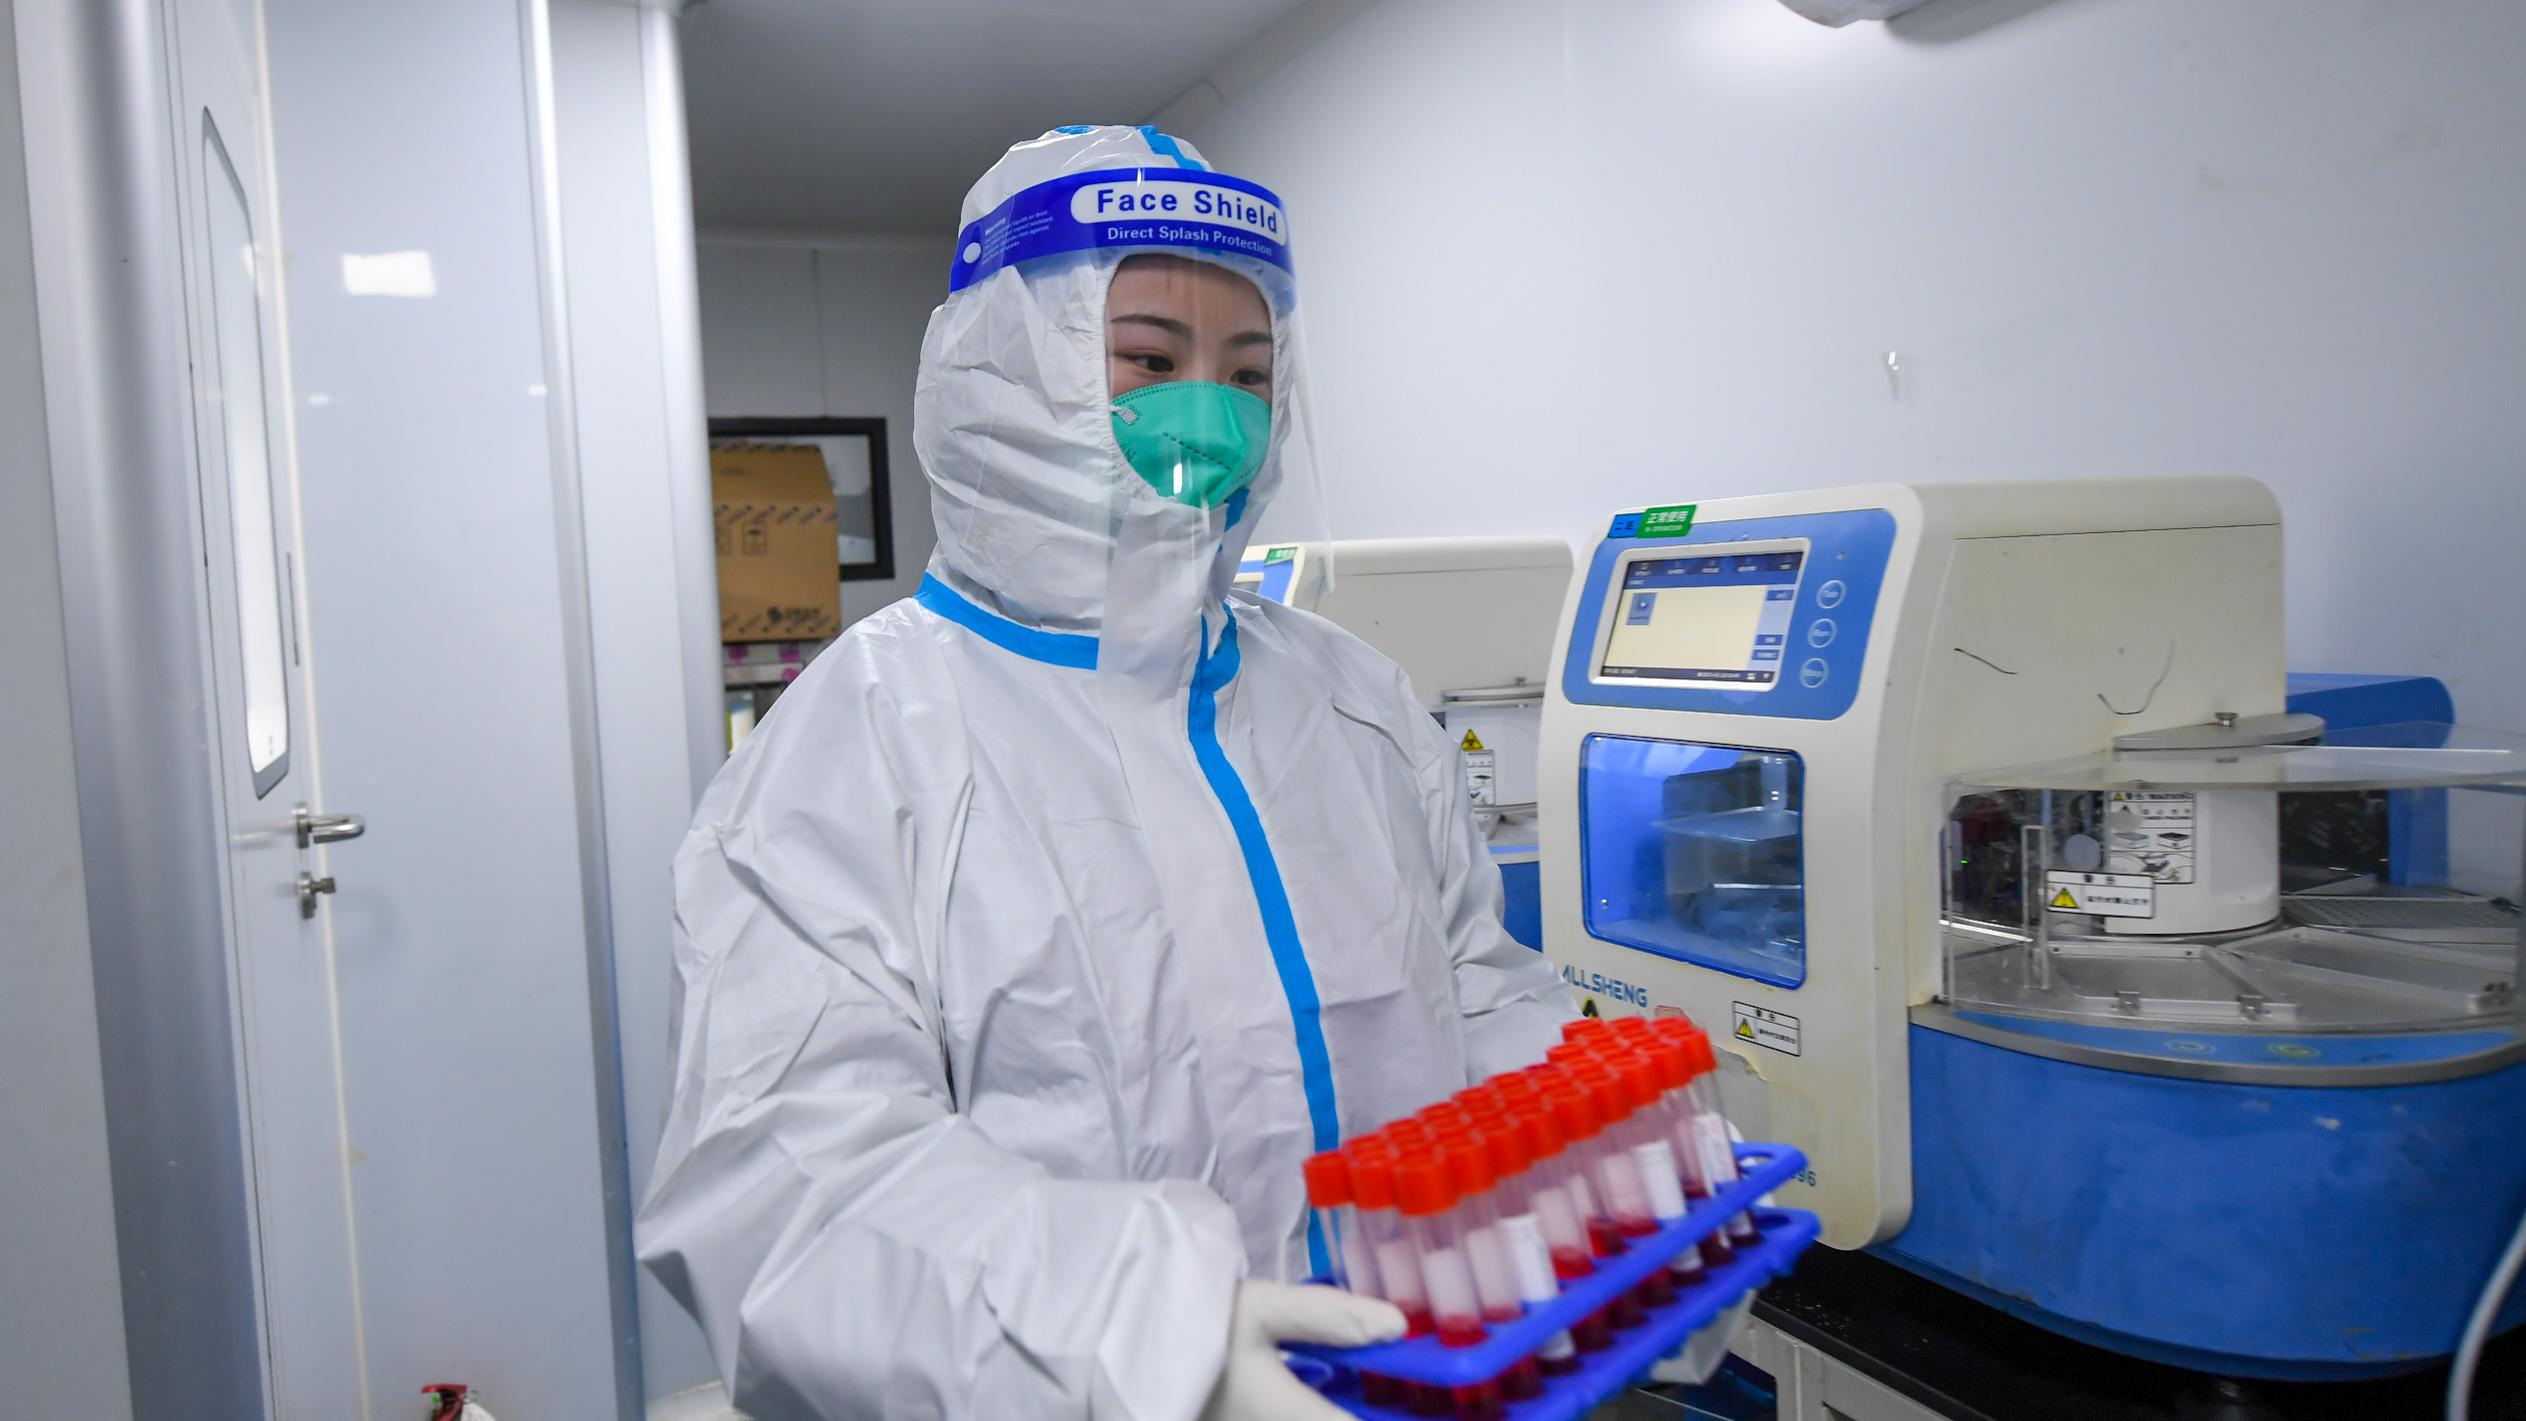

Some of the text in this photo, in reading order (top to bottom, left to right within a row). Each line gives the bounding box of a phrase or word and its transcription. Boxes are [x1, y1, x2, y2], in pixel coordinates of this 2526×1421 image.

[1097, 188, 1278, 235] Face Shield
[1107, 225, 1273, 257] Direct Splash Protection
